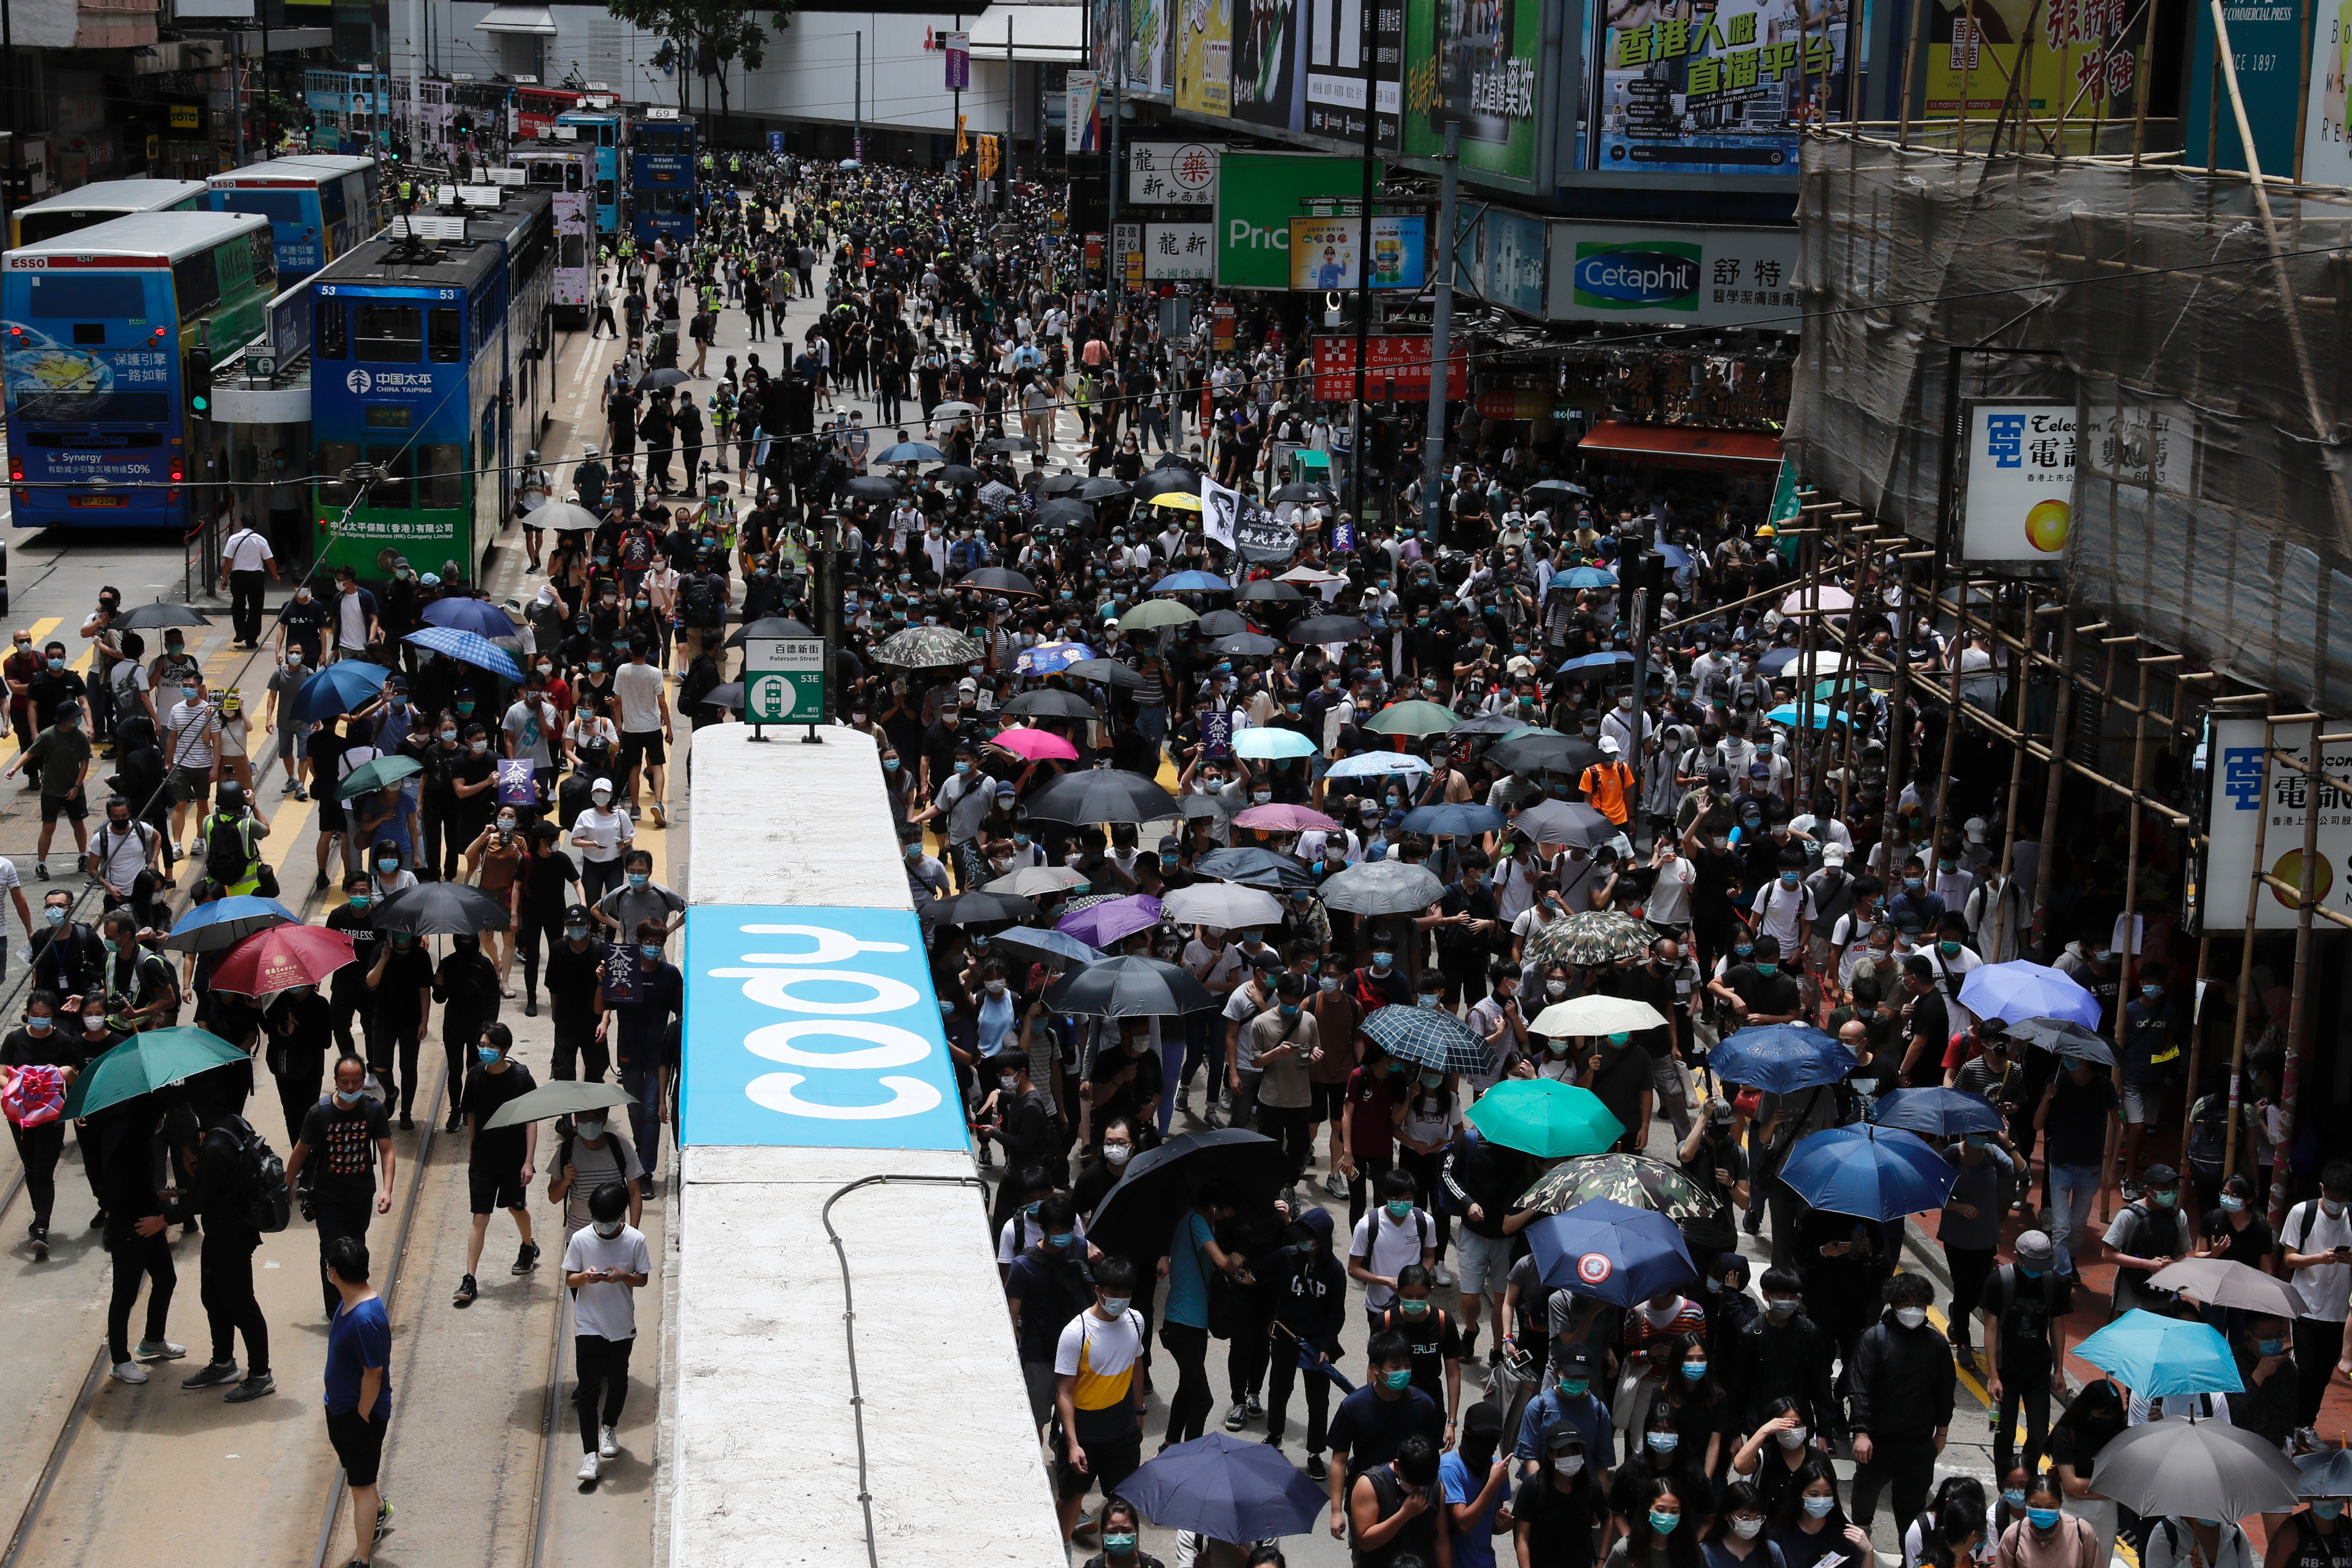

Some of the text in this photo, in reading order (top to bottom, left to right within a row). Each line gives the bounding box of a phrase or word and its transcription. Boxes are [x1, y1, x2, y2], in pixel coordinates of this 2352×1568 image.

[2228, 7, 2292, 21] COMMERCIAL PRESS
[1619, 12, 1757, 68] 香港人嘅
[299, 48, 310, 58] TSL
[1687, 36, 1835, 96] 直播平台
[2253, 54, 2276, 71] 1897
[1471, 56, 1534, 117] 網上直播藥妝
[1689, 90, 1765, 109] www.onliveshow.com
[1968, 101, 1991, 110] mannings
[656, 109, 669, 118] 69
[1180, 151, 1210, 183] 藥
[1167, 190, 1214, 204] 中西藥
[1127, 226, 1136, 250] 信心
[1158, 231, 1207, 256] 龍新
[279, 246, 314, 255] 保護引擎
[12, 259, 45, 268] ESSO
[281, 256, 314, 265] 一路如新
[1154, 268, 1212, 279] 全國快速
[1585, 261, 1690, 294] Cetaphil
[1714, 258, 1781, 288] 舒特
[321, 286, 336, 295] 53
[440, 289, 454, 300] 53
[116, 353, 167, 366] 保護引擎
[116, 369, 167, 382] 一路如新
[376, 373, 432, 385] 中国太平
[1631, 395, 1653, 410] SUN
[1663, 397, 1707, 414] CHEUNG
[1569, 410, 1582, 418] 保證
[63, 453, 102, 463] Synergy
[1238, 529, 1298, 548] 時代革命
[775, 644, 818, 654] 百德新街
[1208, 713, 1228, 748] 天滅中共
[505, 760, 529, 794] 天滅中共
[2272, 816, 2352, 826] 香港上公司股
[608, 943, 634, 988] 天滅中共
[707, 924, 941, 1120] cody
